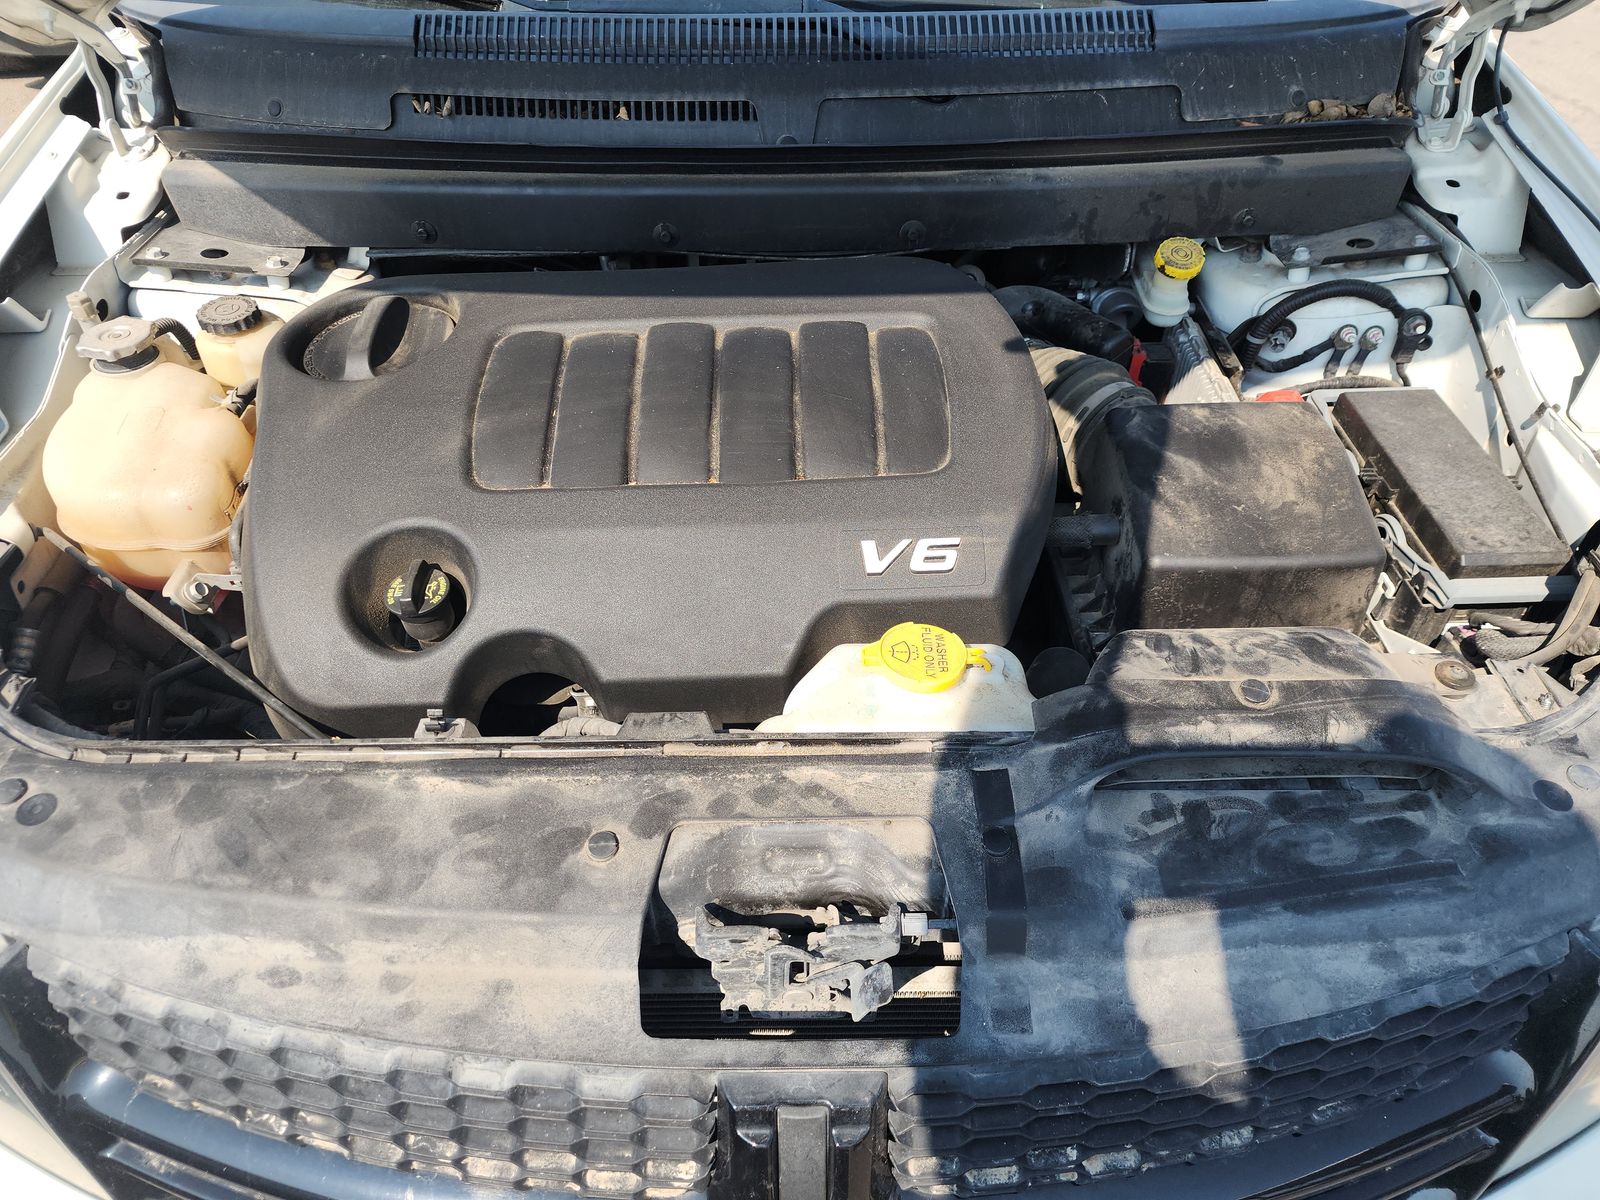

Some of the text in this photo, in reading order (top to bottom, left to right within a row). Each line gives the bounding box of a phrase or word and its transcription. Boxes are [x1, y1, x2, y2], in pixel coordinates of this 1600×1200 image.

[860, 537, 961, 577] V6
[430, 576, 447, 604] ENGINE OIL
[921, 626, 937, 679] FLUID ONLY
[934, 633, 949, 673] WASHER
